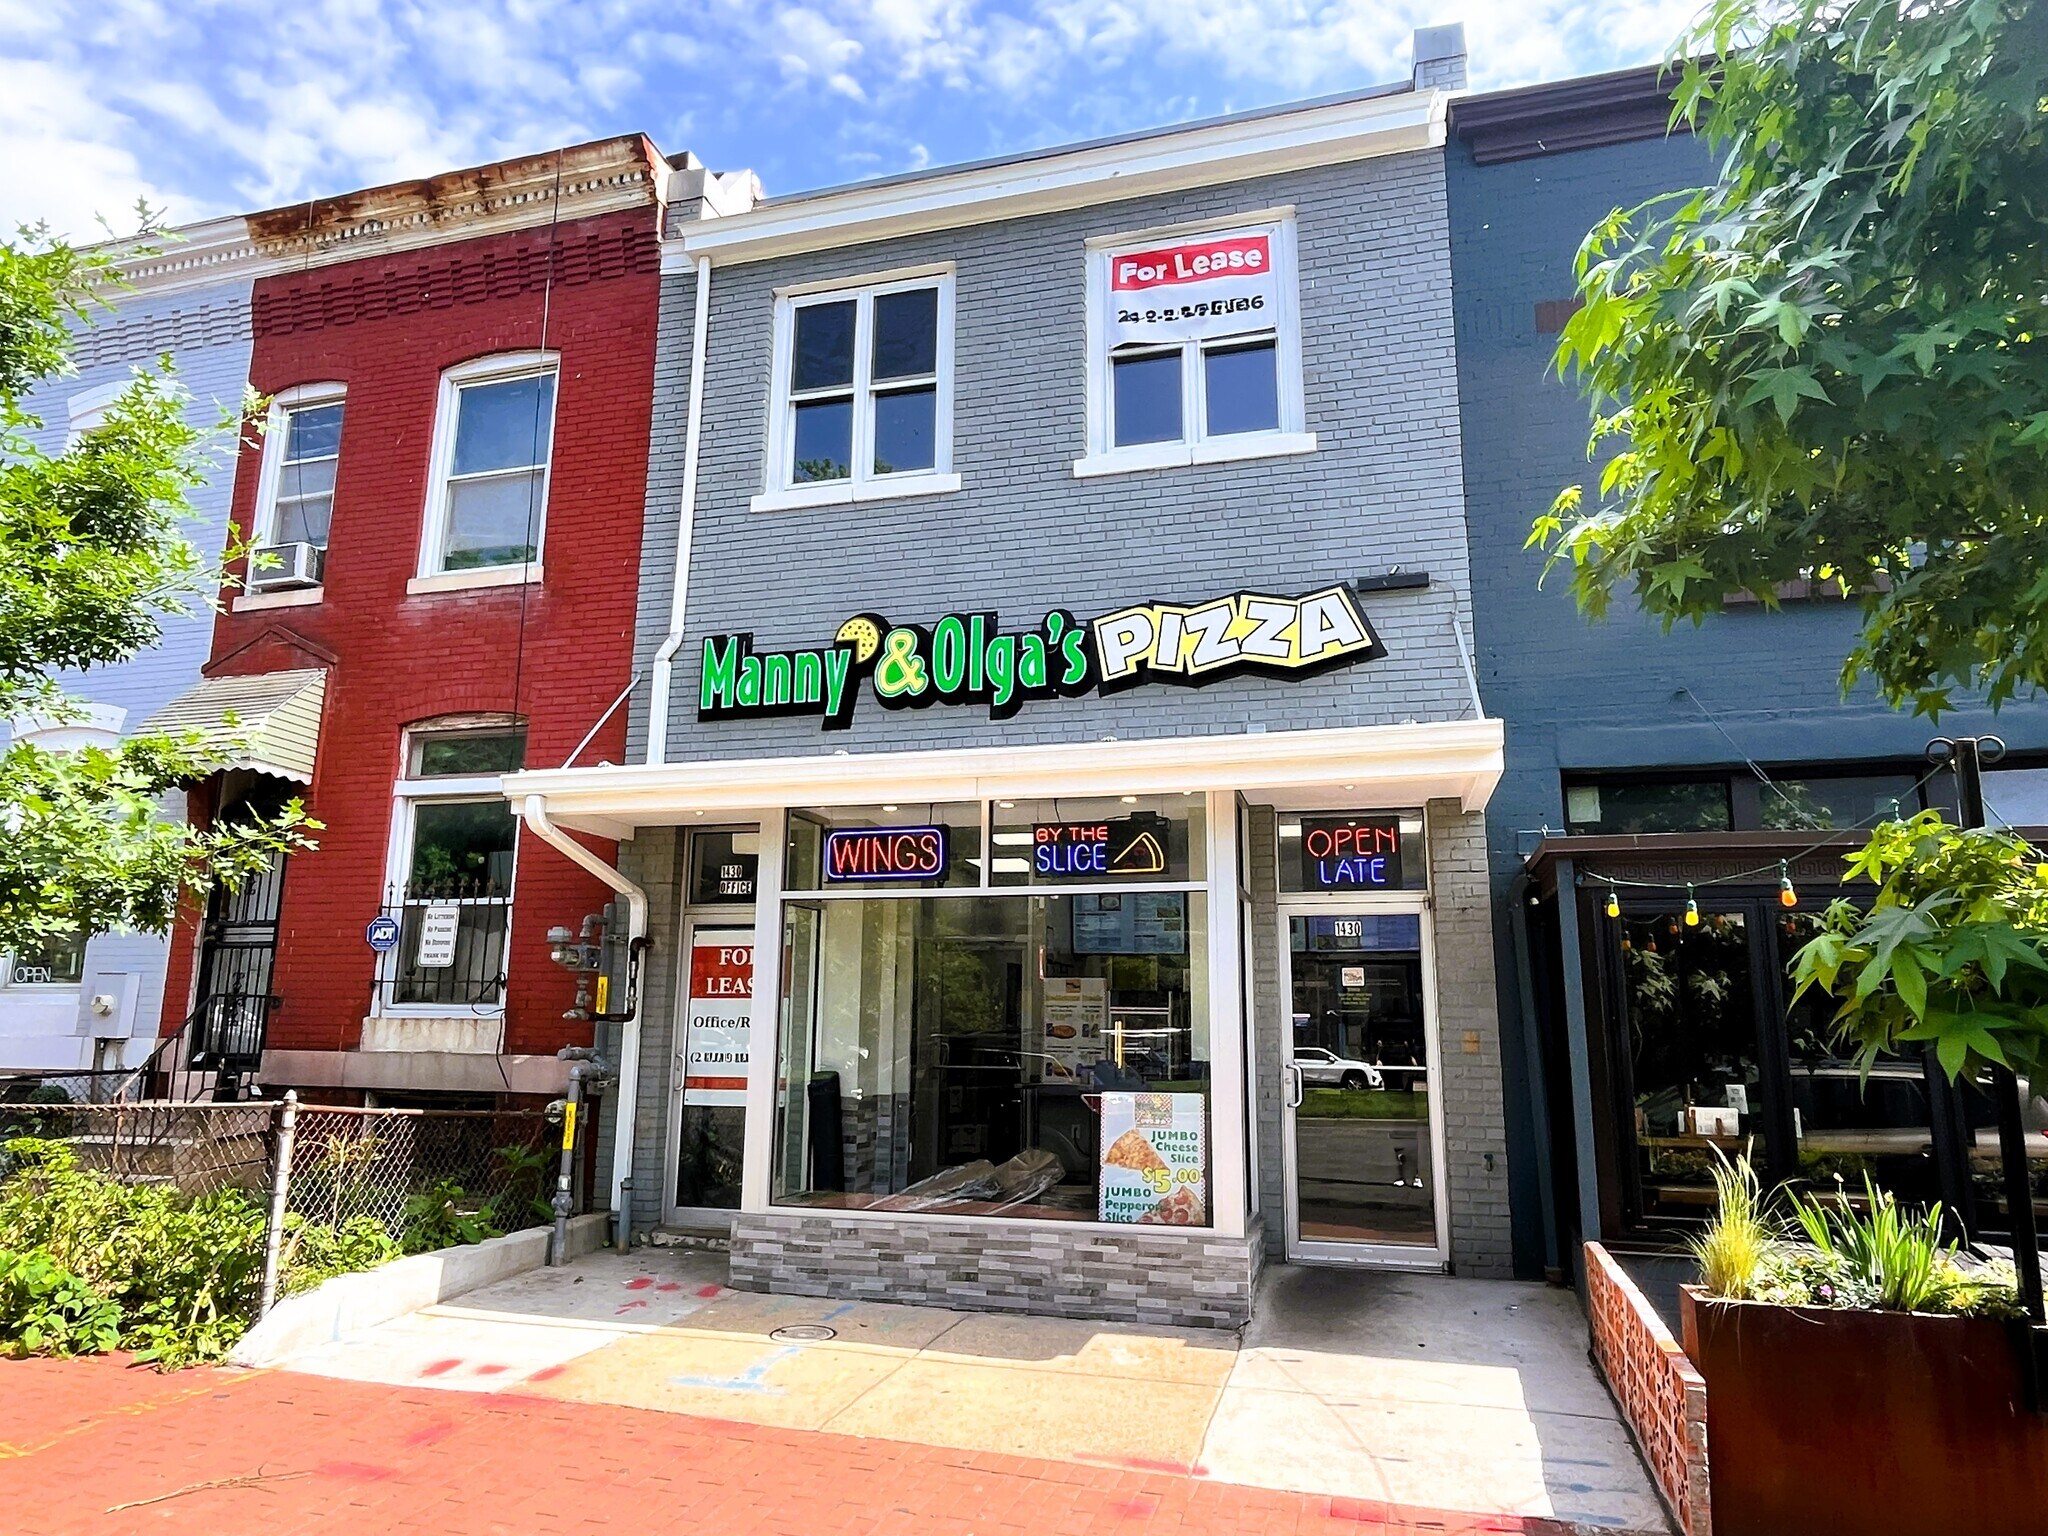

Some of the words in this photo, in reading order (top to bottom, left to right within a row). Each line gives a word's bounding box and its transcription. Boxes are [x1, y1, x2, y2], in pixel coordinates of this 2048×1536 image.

[1119, 262, 1168, 284] For
[1174, 248, 1263, 279] Lease
[700, 636, 852, 716] Manny
[875, 628, 928, 698] &
[932, 612, 1086, 706] Olga's
[1095, 588, 1372, 680] PIZZA
[1035, 828, 1062, 843] BY
[1068, 826, 1108, 841] THE
[1307, 827, 1396, 857] OPEN
[833, 834, 938, 873] WINGS
[1035, 843, 1107, 872] SLICE
[721, 865, 743, 878] 1430
[1320, 858, 1385, 884] LATE
[720, 881, 752, 894] OFFICE
[373, 927, 395, 940] ADT
[1335, 921, 1361, 936] 1430
[719, 948, 754, 966] FO
[15, 966, 51, 982] OPEN
[706, 977, 752, 995] LEAS
[693, 1016, 751, 1029] Office/R
[1151, 1130, 1198, 1142] JUMBO
[1156, 1142, 1199, 1153] Cheese
[1170, 1154, 1199, 1163] Slice
[1142, 1166, 1200, 1194] $5.00
[1105, 1186, 1152, 1199] JUMBO
[1105, 1212, 1133, 1223] Slice
